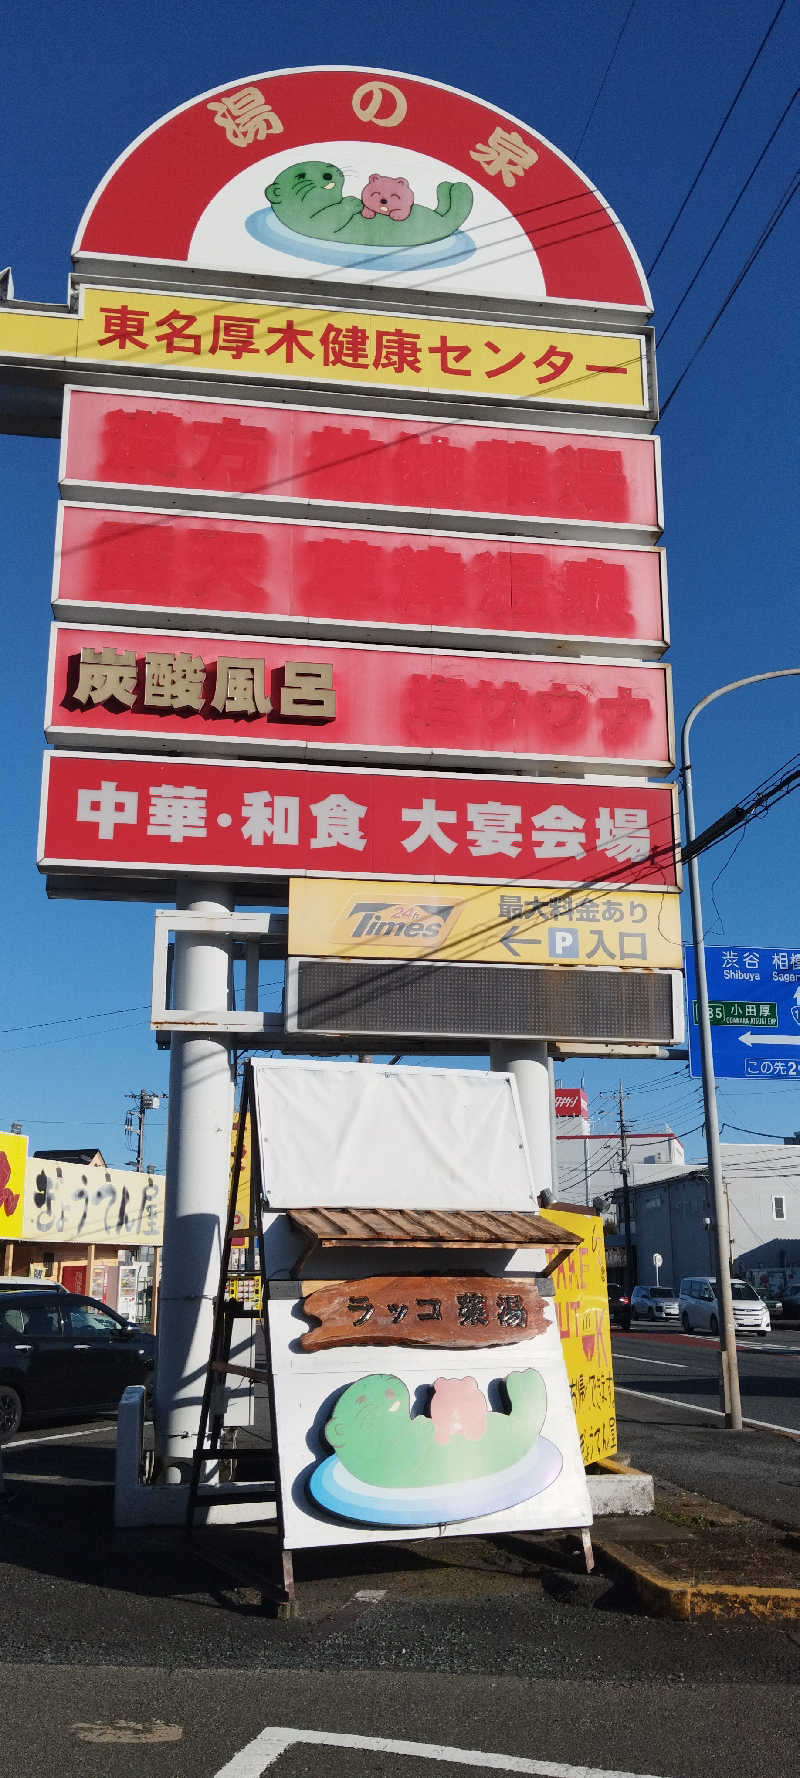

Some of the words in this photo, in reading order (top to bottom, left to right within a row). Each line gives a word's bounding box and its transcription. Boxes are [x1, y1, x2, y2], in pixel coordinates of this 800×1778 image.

[207, 81, 539, 188] 湯の泉
[98, 304, 628, 386] 東名厚木健康センター
[74, 646, 338, 722] 炭酸風呂
[75, 780, 368, 852] 中華・和食
[401, 798, 652, 864] 大宴会場
[347, 902, 442, 938] Times
[498, 894, 648, 925] 最大料金あり
[585, 929, 648, 962] 入口
[721, 950, 760, 969] 渋谷
[723, 970, 761, 982] Shibuya
[730, 1003, 772, 1017] 小田厚
